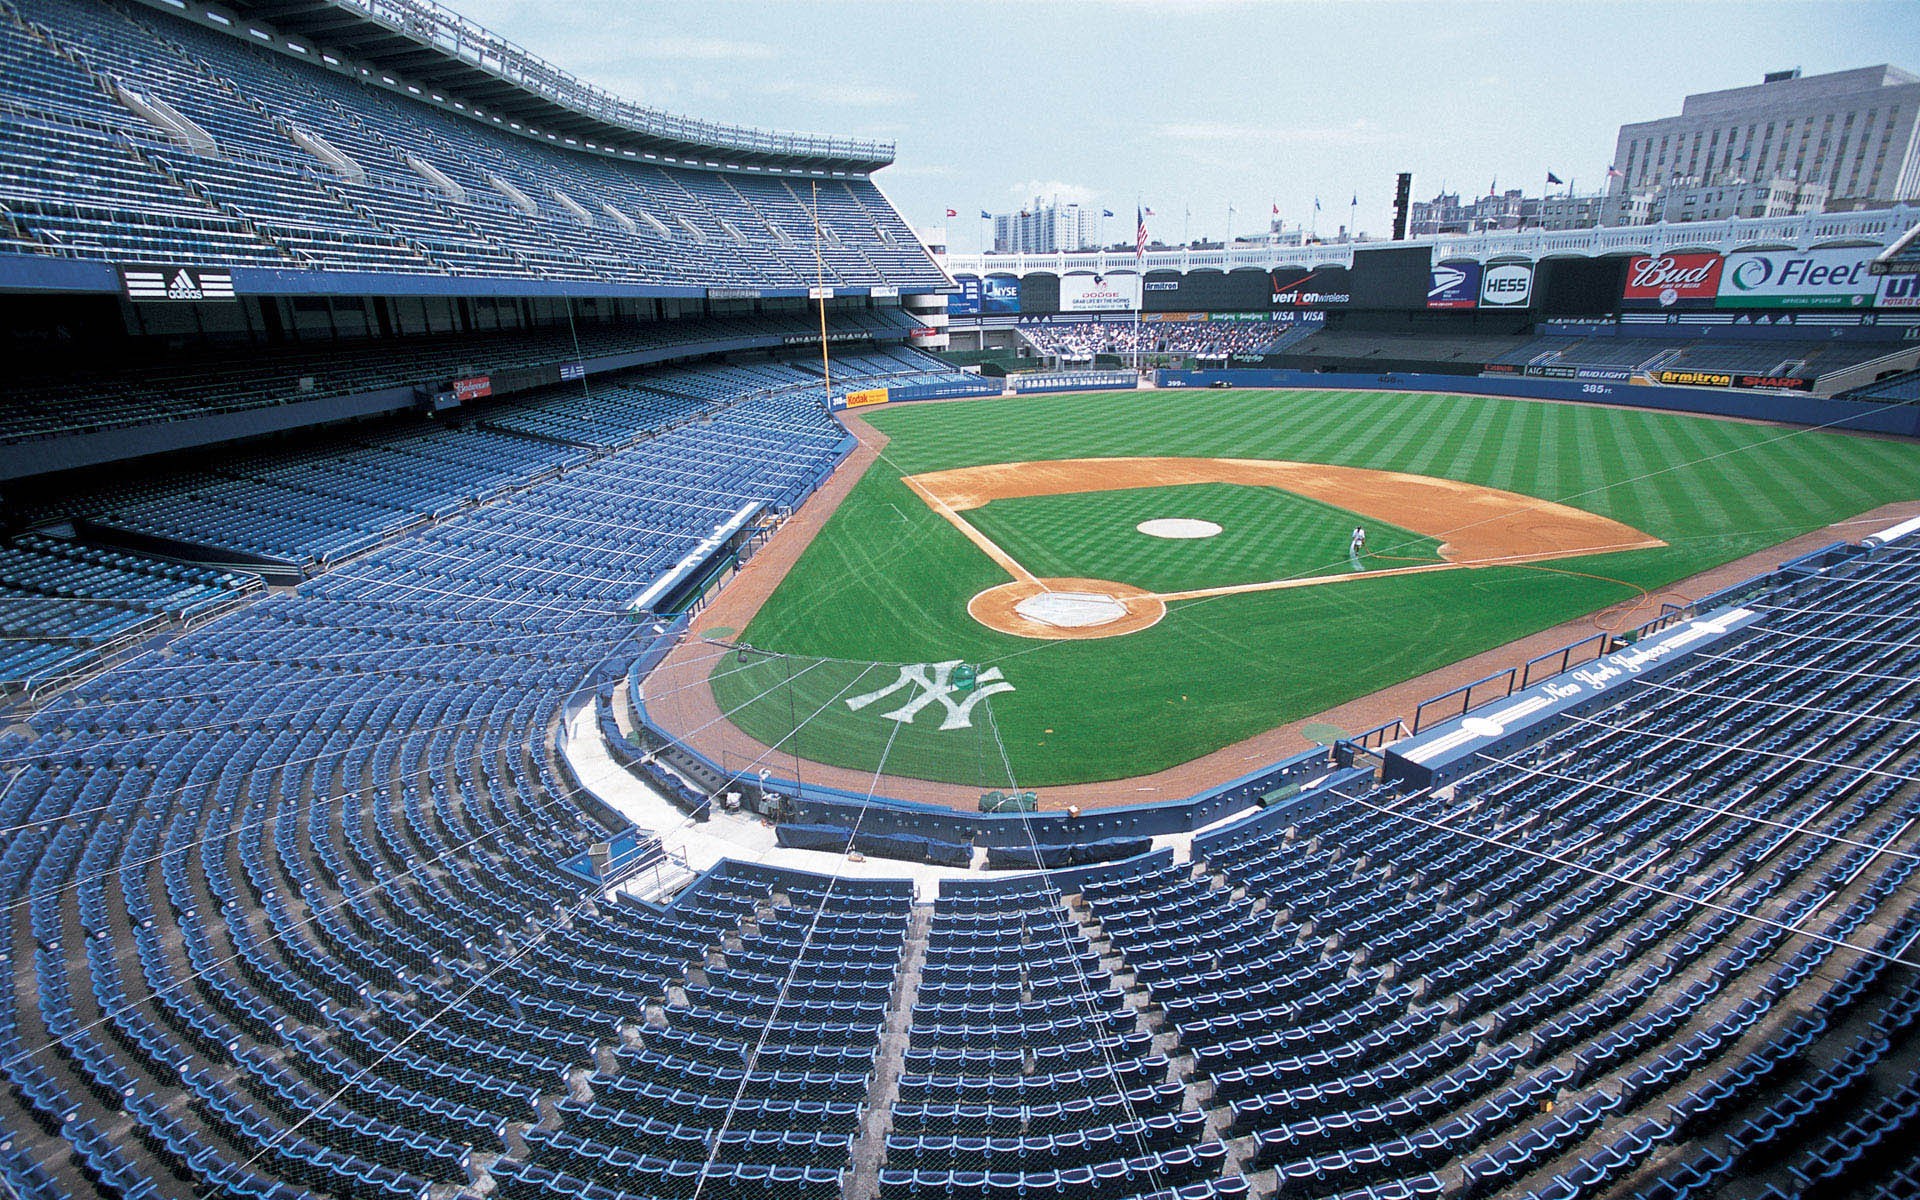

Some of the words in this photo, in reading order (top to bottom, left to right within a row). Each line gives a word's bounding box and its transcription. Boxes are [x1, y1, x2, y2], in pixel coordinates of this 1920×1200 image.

[1631, 257, 1718, 287] Bud
[1777, 259, 1866, 286] Fleet
[1487, 279, 1527, 292] HESS
[168, 287, 203, 299] adidas
[1272, 312, 1295, 320] VISA
[1303, 311, 1324, 320] VISA
[1528, 367, 1543, 375] AIG
[1600, 371, 1629, 379] LIGHT
[1662, 371, 1730, 384] Armitron
[1742, 376, 1803, 387] SHARP
[1582, 384, 1604, 393] 385
[847, 393, 868, 406] Kodak
